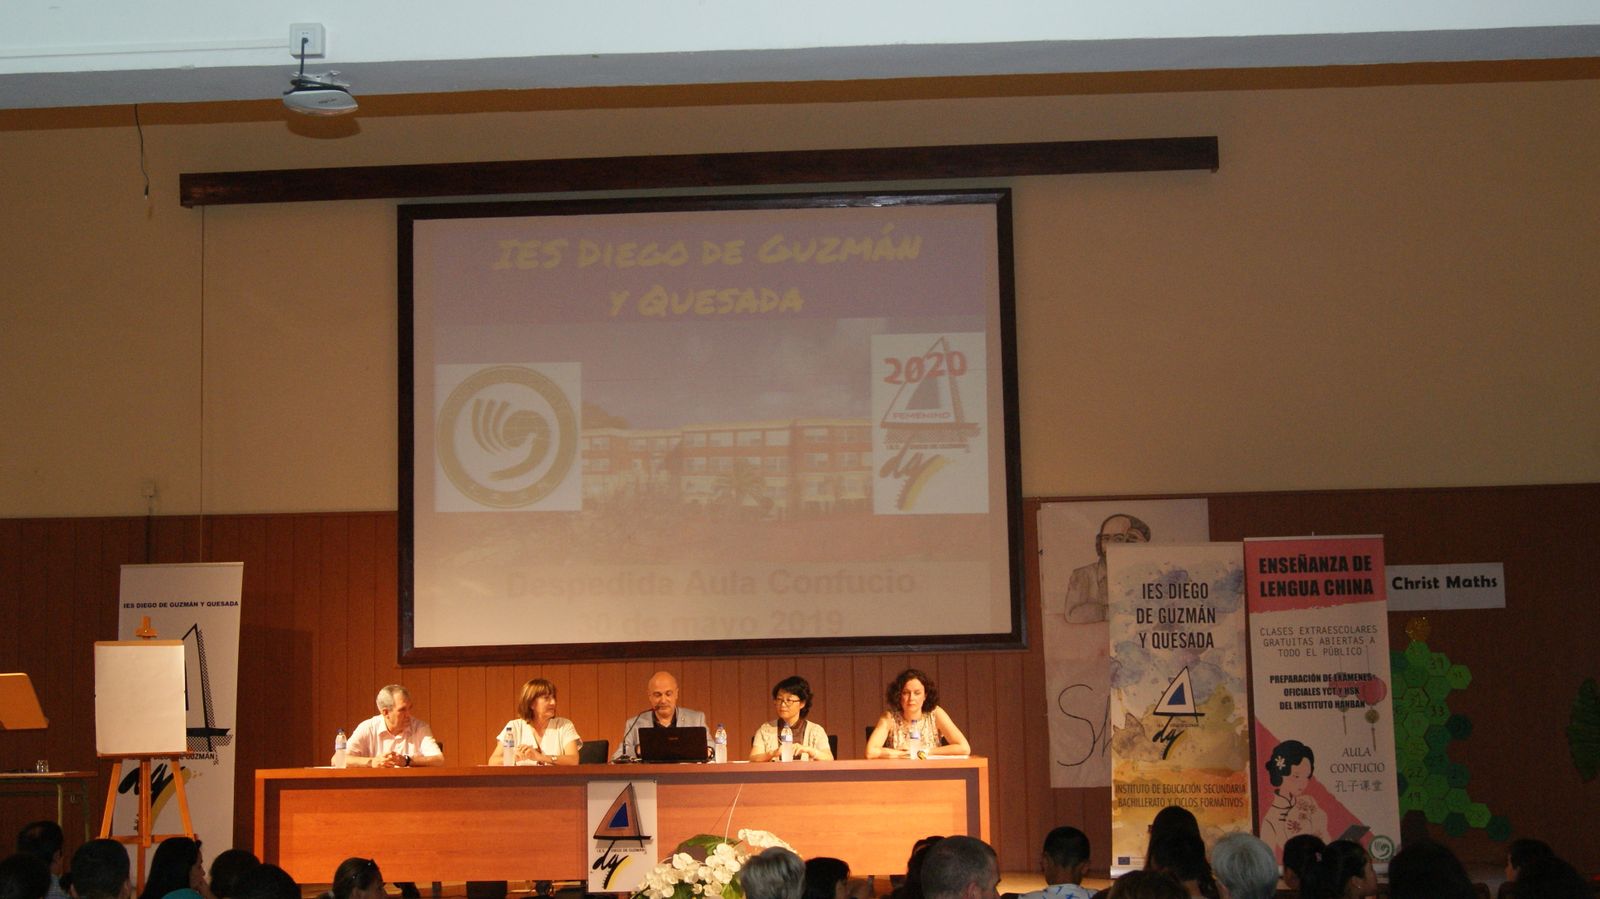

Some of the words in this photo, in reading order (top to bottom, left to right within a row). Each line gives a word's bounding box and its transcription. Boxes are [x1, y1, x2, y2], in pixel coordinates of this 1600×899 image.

[495, 239, 569, 269] IES
[577, 239, 689, 269] DIEGO
[702, 240, 745, 266] DE
[757, 223, 923, 264] GUZMÁN
[609, 290, 630, 317] Y
[637, 284, 804, 317] QUESADA
[883, 351, 967, 385] 2020
[1259, 554, 1349, 574] ENSEÑANZA
[1353, 555, 1372, 571] DE
[506, 572, 674, 604] Despedida
[687, 570, 757, 596] Aula
[767, 569, 917, 595] Confucio
[1260, 580, 1320, 597] LENGUA
[1324, 578, 1374, 595] CHINA
[1392, 576, 1440, 590] Christ
[1446, 575, 1498, 589] Maths
[1142, 583, 1163, 599] IES
[1169, 583, 1209, 599] DIEGO
[169, 600, 198, 608] GUZMÁN
[1136, 608, 1153, 624] DE
[1158, 605, 1216, 624] GUZMÁN
[623, 611, 659, 637] de
[671, 614, 757, 640] mayo
[770, 610, 844, 635] 2019
[1260, 627, 1294, 636] CLASES
[1300, 625, 1378, 635] EXTRAESCOLARES
[1139, 632, 1147, 648] Y
[1152, 632, 1214, 649] QUESADA
[1263, 638, 1314, 647] GRATUITAS
[1320, 636, 1364, 646] ABIERTAS
[1279, 648, 1300, 657] TODO
[1306, 648, 1317, 656] EL
[1323, 646, 1362, 657] PÚBLICO
[1269, 674, 1321, 684] PREPARACIÓN
[1322, 674, 1332, 682] DE
[1283, 687, 1321, 697] OFICIALES
[1322, 687, 1336, 696] YCT
[1344, 687, 1360, 695] HSK
[1279, 701, 1293, 710] DEL
[1294, 700, 1333, 709] INSTITUTO
[1335, 700, 1366, 709] HANBAN
[1342, 747, 1372, 758] AULA
[1330, 763, 1385, 774] CONFUCIO
[1115, 784, 1150, 795] INSTITUTO
[1152, 784, 1162, 794] DE
[1163, 783, 1201, 794] EDUCACIÓN
[1203, 784, 1246, 794] SECUNDARIA
[1118, 796, 1165, 807] BACHILLERATO
[1167, 797, 1172, 806] Y
[1174, 797, 1199, 808] CICLOS
[1200, 796, 1244, 808] FORMATIVOS
